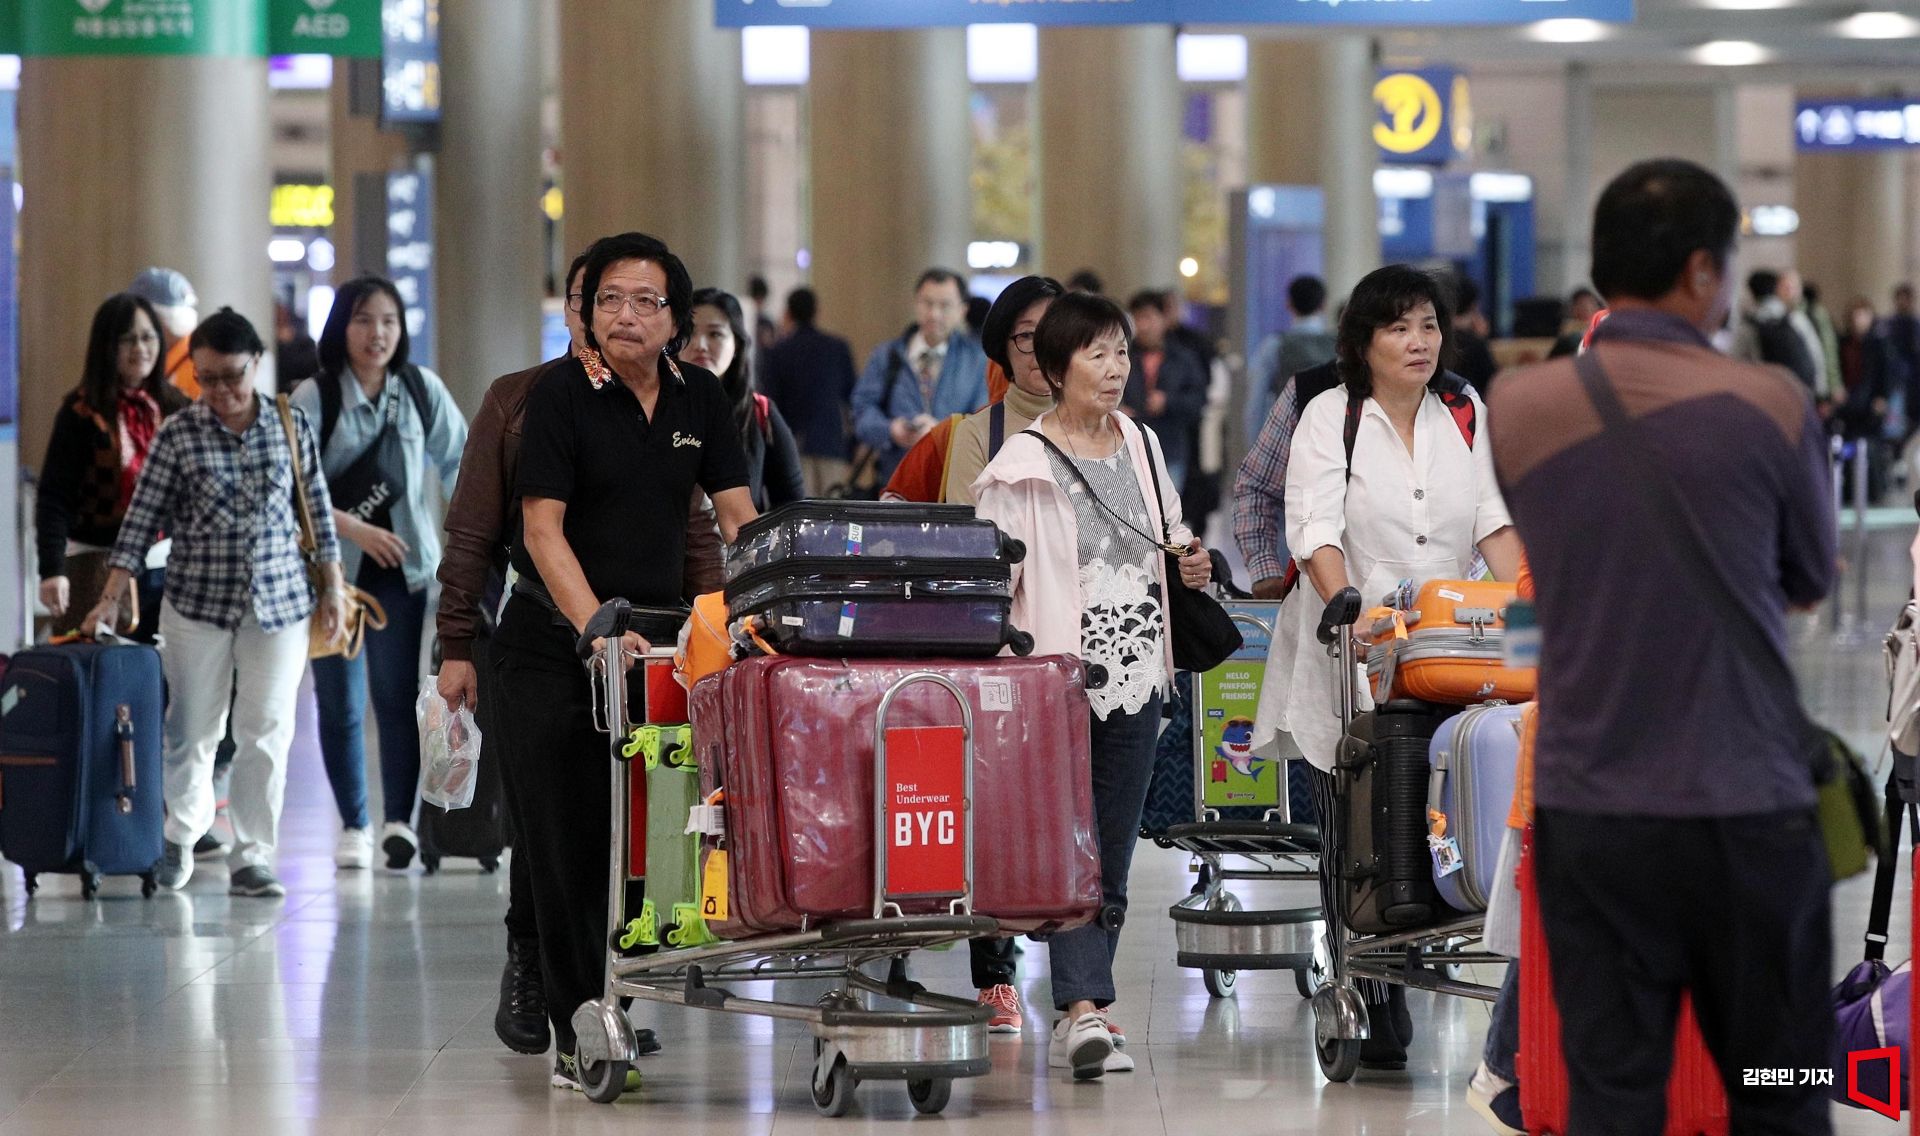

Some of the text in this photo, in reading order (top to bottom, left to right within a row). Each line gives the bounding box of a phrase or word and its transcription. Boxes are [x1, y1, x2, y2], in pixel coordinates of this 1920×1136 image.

[293, 13, 350, 38] AED
[1225, 671, 1250, 680] HELLO
[1218, 682, 1257, 690] PINKFONG
[1221, 692, 1255, 700] FRIENDS!
[896, 783, 918, 793] Best
[896, 794, 950, 805] Underwear
[895, 810, 955, 847] BYC
